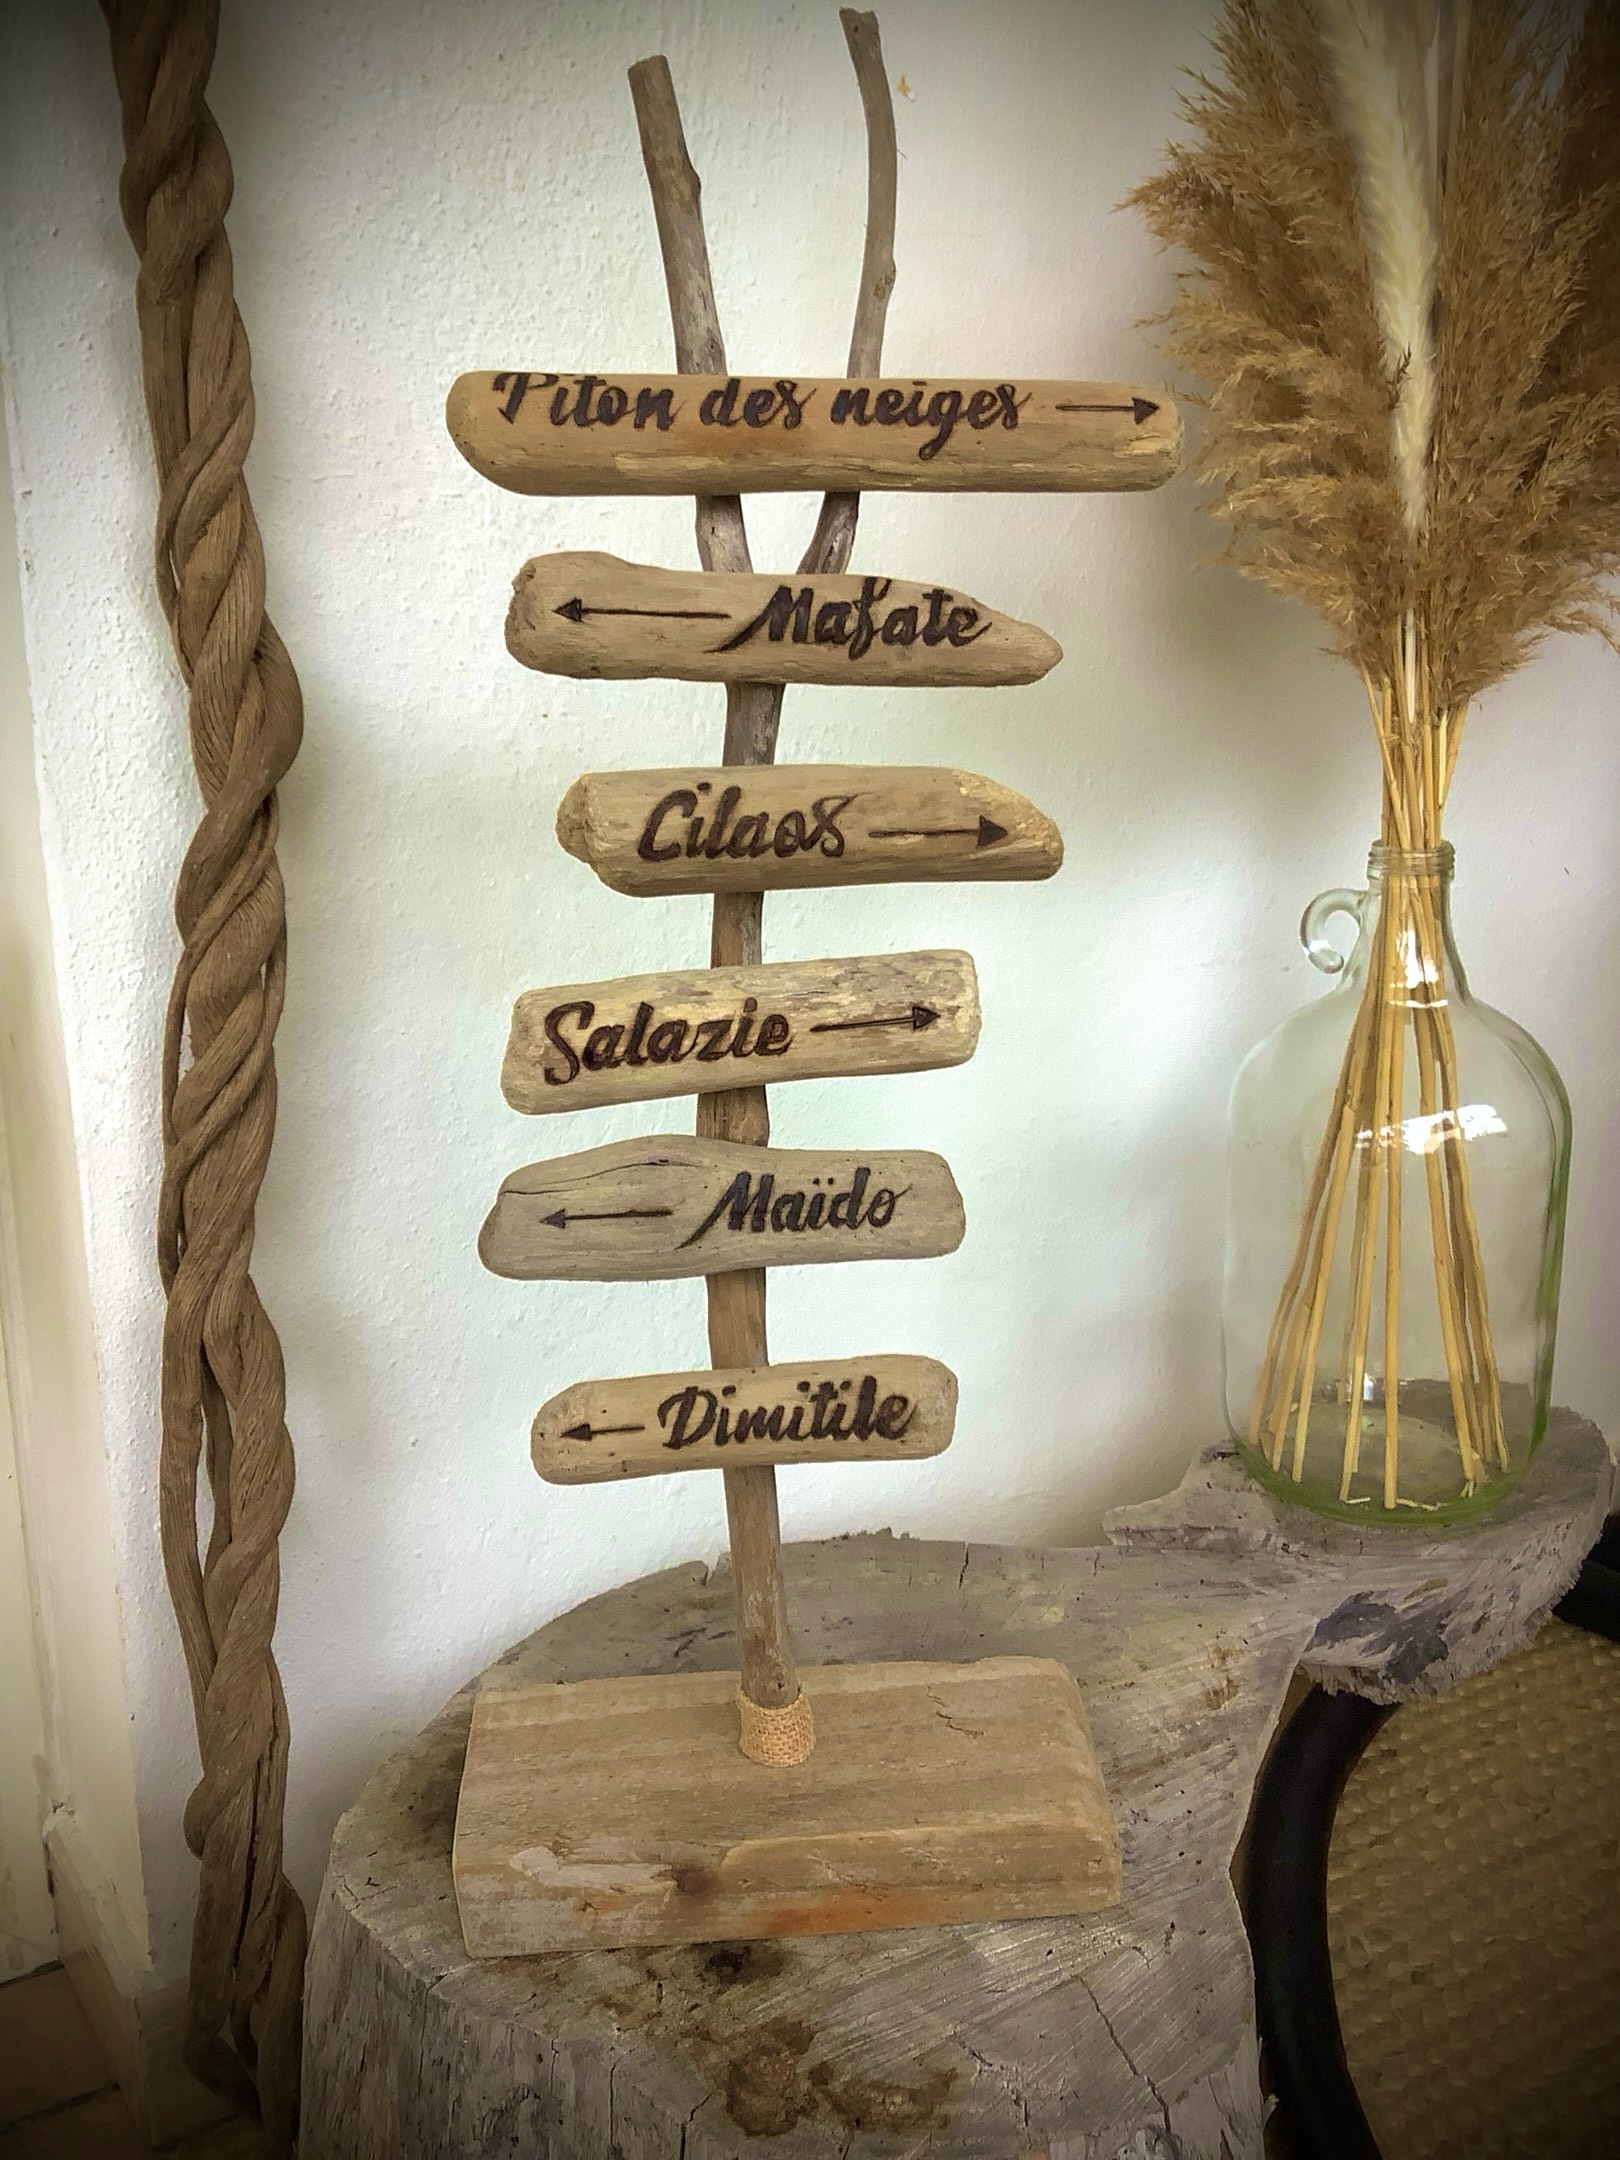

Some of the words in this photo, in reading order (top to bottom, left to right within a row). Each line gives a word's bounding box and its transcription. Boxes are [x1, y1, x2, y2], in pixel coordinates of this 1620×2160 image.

[492, 372, 685, 431] Piton
[700, 378, 817, 430] des
[830, 380, 1032, 461] neiges
[702, 576, 992, 660] Mafate
[637, 782, 876, 862] Cilaos
[544, 997, 797, 1086] Salazie
[673, 1167, 912, 1250] Maïdo
[657, 1375, 917, 1450] Dimitile
